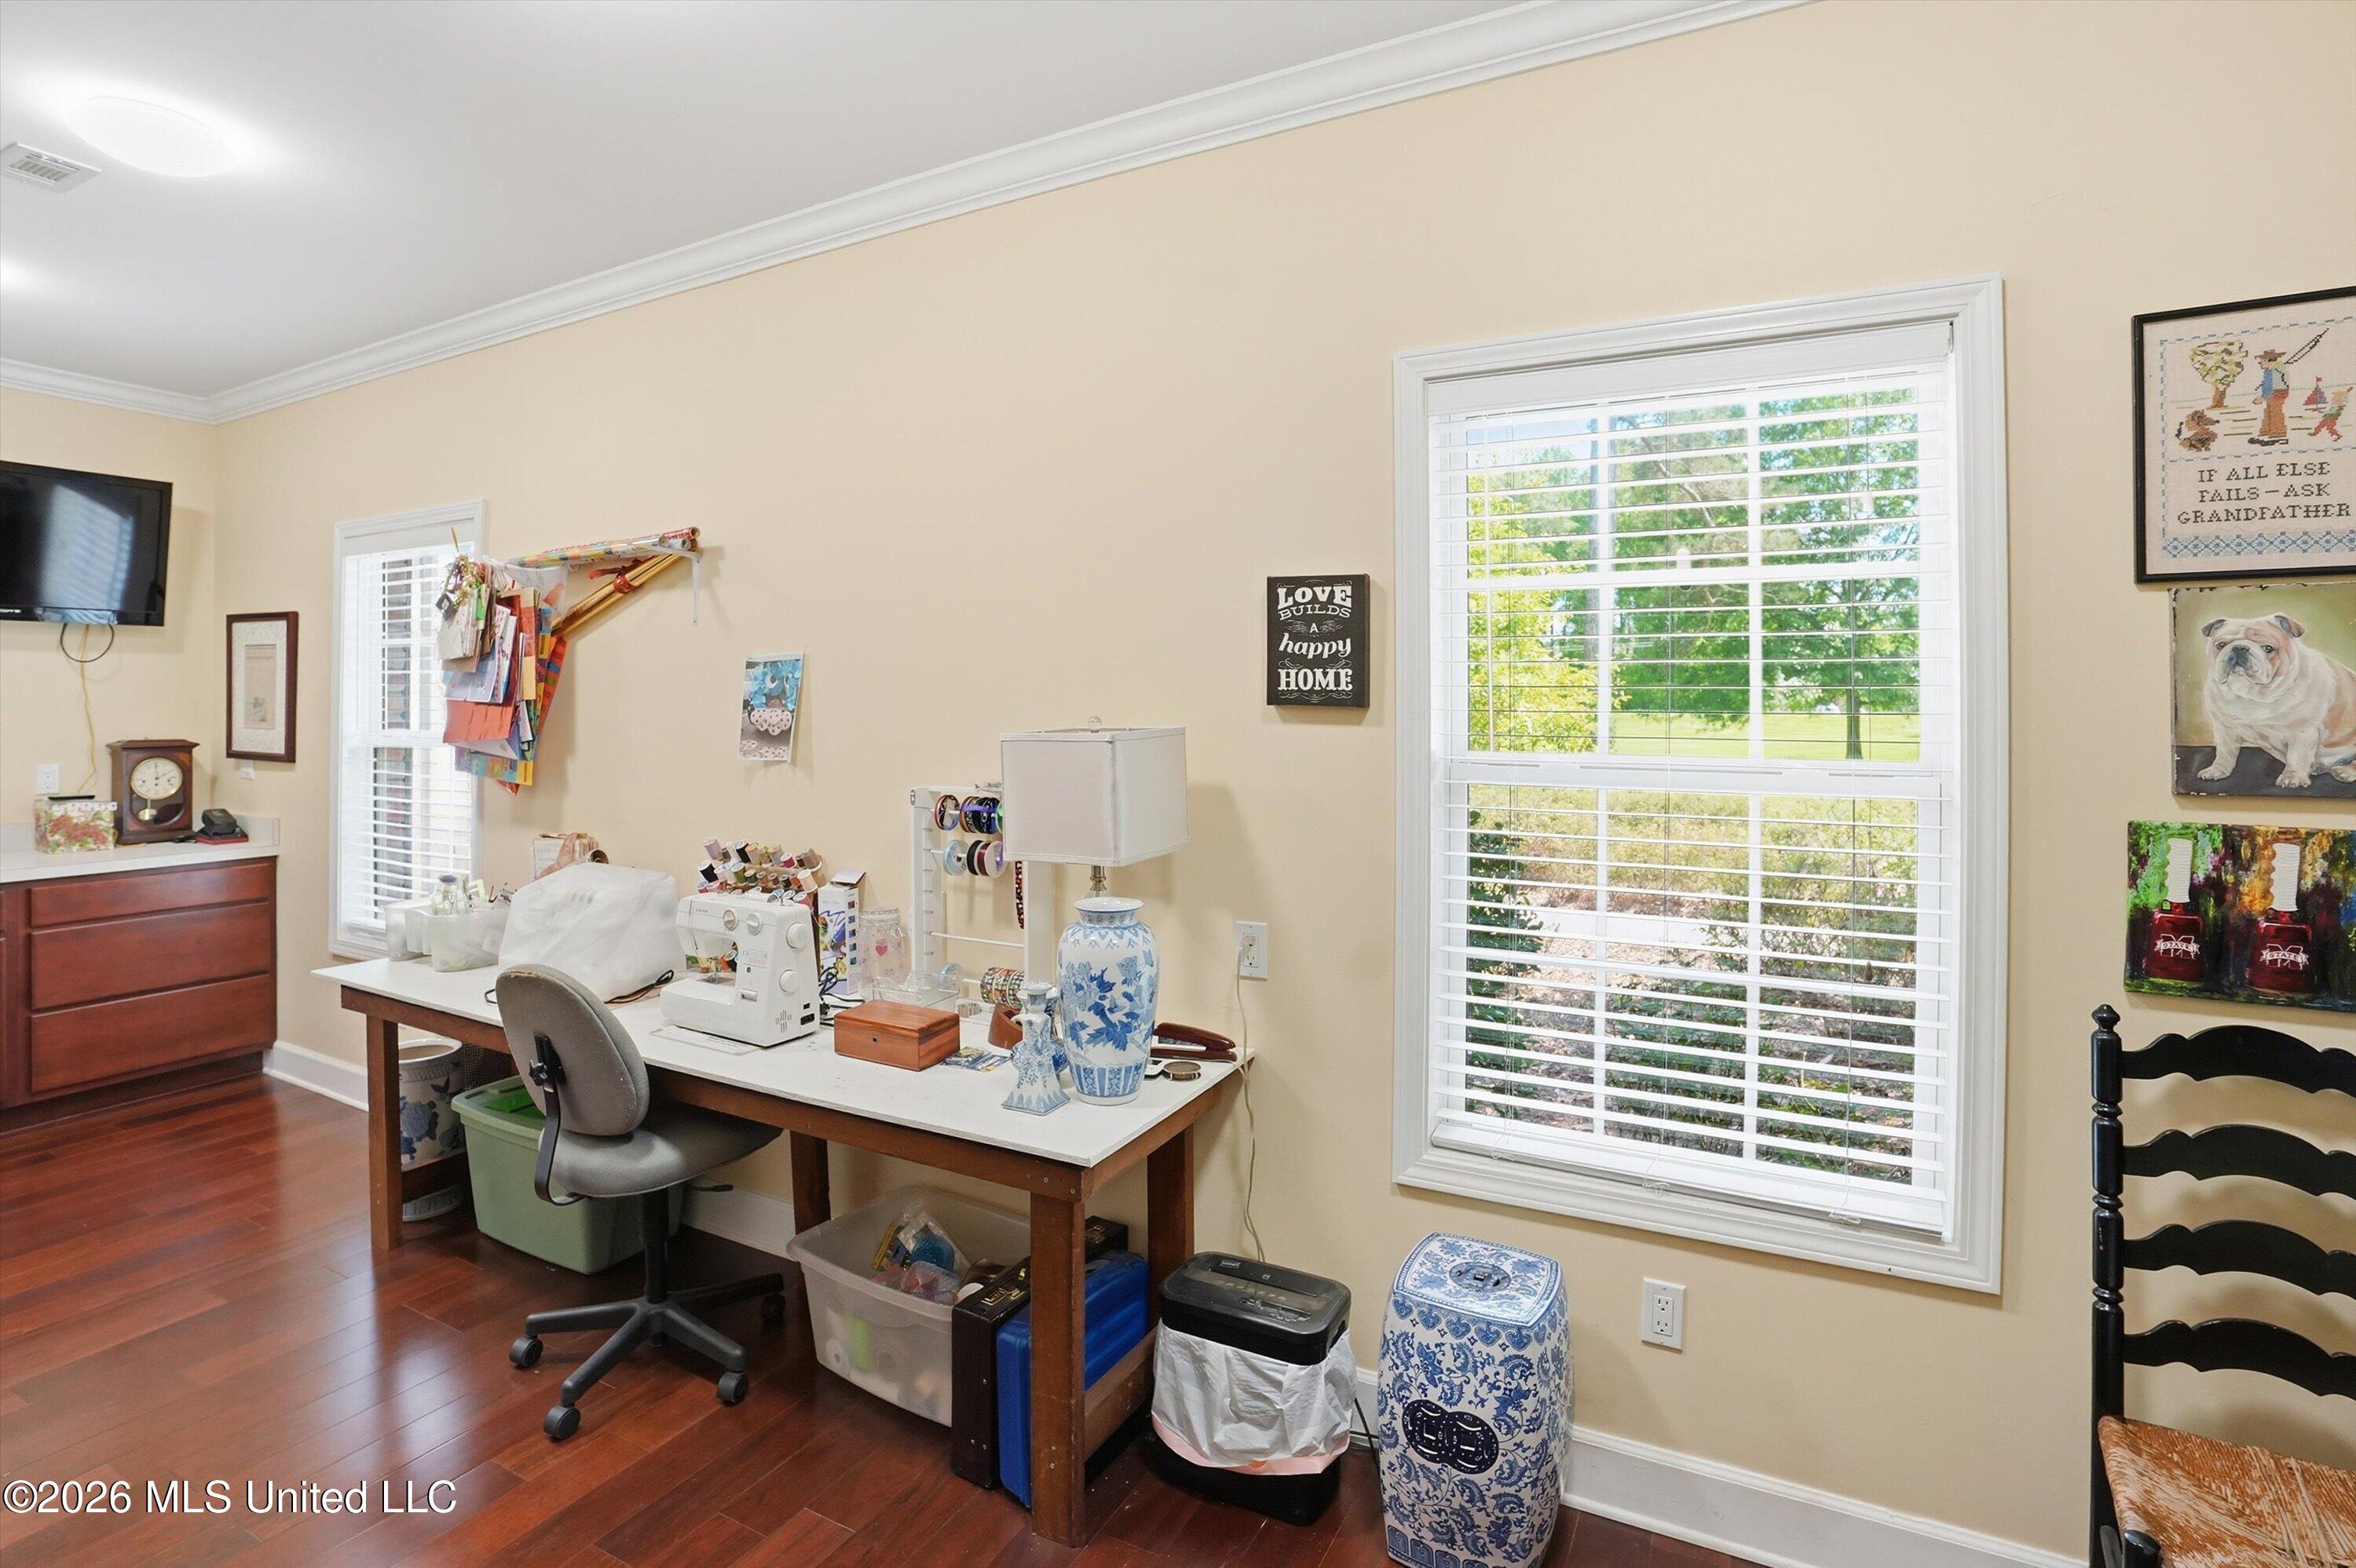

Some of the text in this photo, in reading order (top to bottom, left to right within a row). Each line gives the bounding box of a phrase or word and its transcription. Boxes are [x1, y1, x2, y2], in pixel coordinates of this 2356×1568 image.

[2198, 462, 2331, 483] IF ALL ELSE
[2199, 487, 2260, 503] FAILS
[2283, 483, 2331, 499] ASK
[2177, 503, 2351, 524] GRANDFATHER
[1277, 585, 1352, 610] LOVE
[1278, 604, 1352, 620] BUILDS
[1309, 623, 1319, 633] A
[1279, 633, 1352, 659] happy
[1278, 668, 1353, 691] HOME
